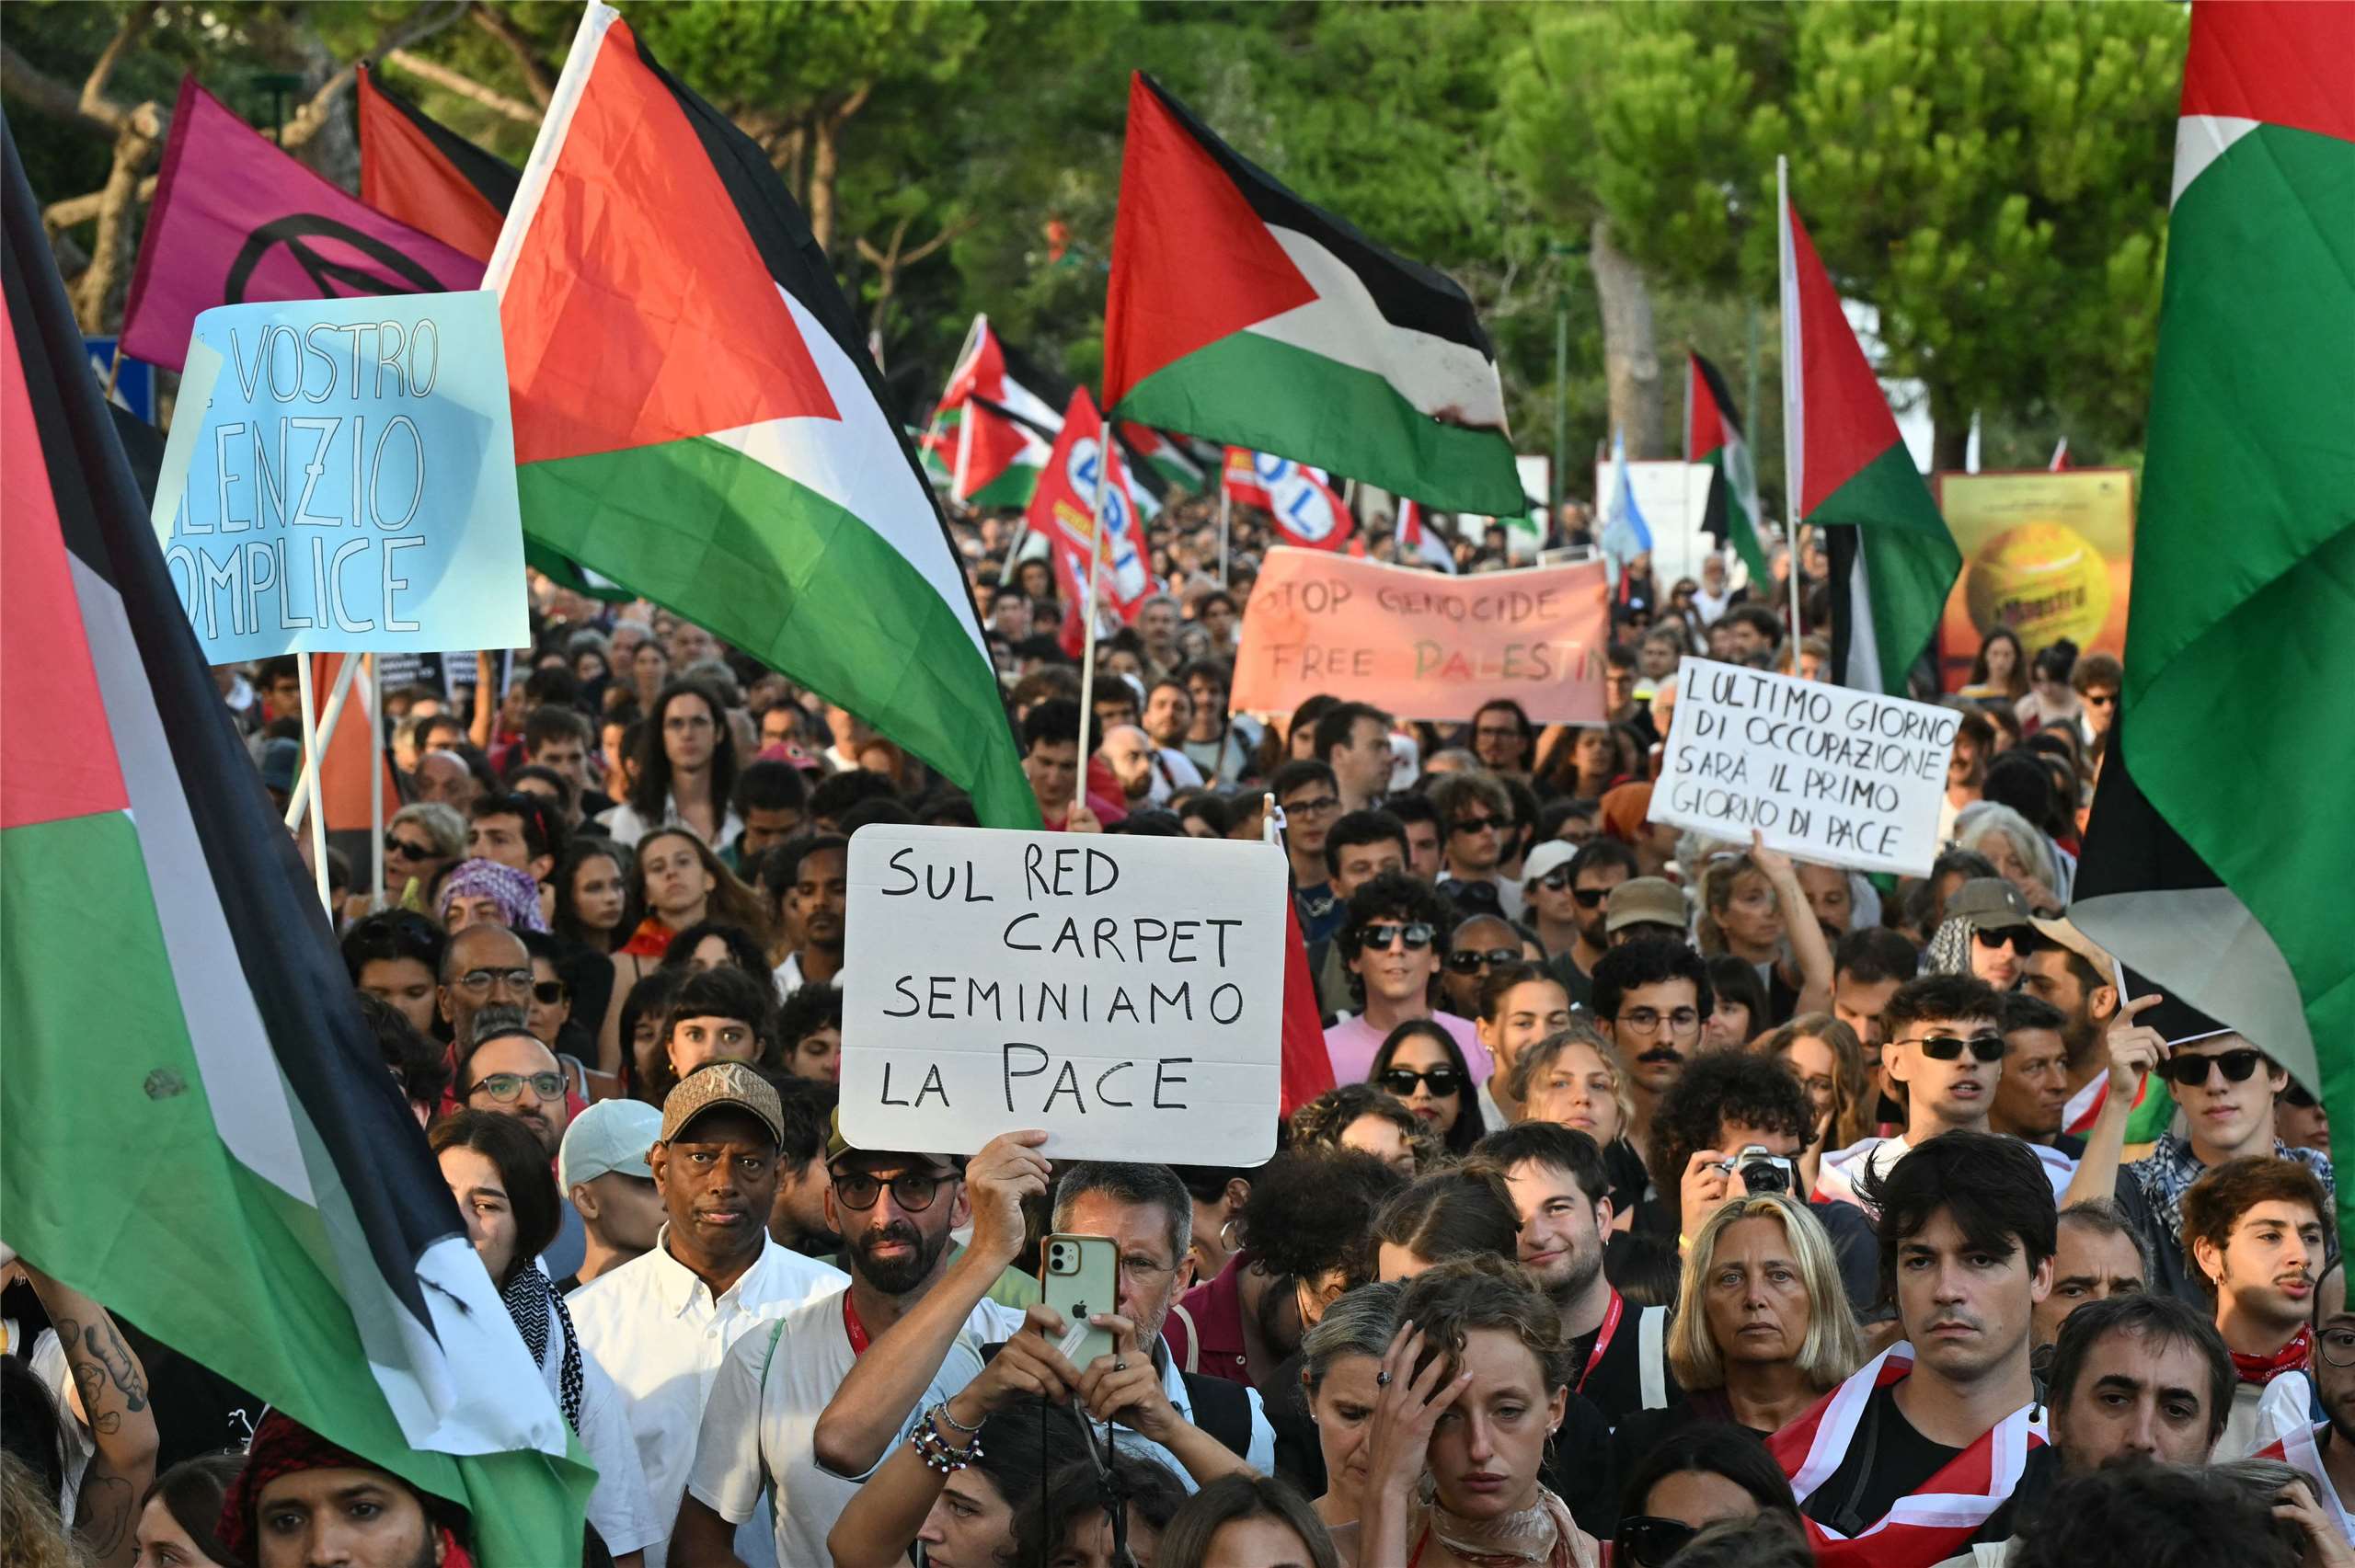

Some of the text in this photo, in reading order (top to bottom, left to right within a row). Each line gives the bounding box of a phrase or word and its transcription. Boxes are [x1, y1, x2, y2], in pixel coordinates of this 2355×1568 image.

[230, 317, 439, 405] VOSTRO
[169, 414, 426, 539] LENZIO
[1376, 585, 1559, 623] GENOCIDE
[1262, 643, 1373, 682] FREE
[1695, 709, 1942, 781] DI OCCUPAZIONE
[1844, 699, 1956, 747] GIORNO
[1769, 764, 1792, 793] IL
[1804, 768, 1900, 813] PRIMO
[1671, 780, 1903, 858] GIORNO DI PACE
[880, 842, 1120, 902] SUL RED
[1003, 912, 1243, 968] CARPET
[881, 975, 1244, 1025] SEMINIAMO
[706, 1063, 744, 1094] NY
[880, 1042, 1194, 1115] LA PACE
